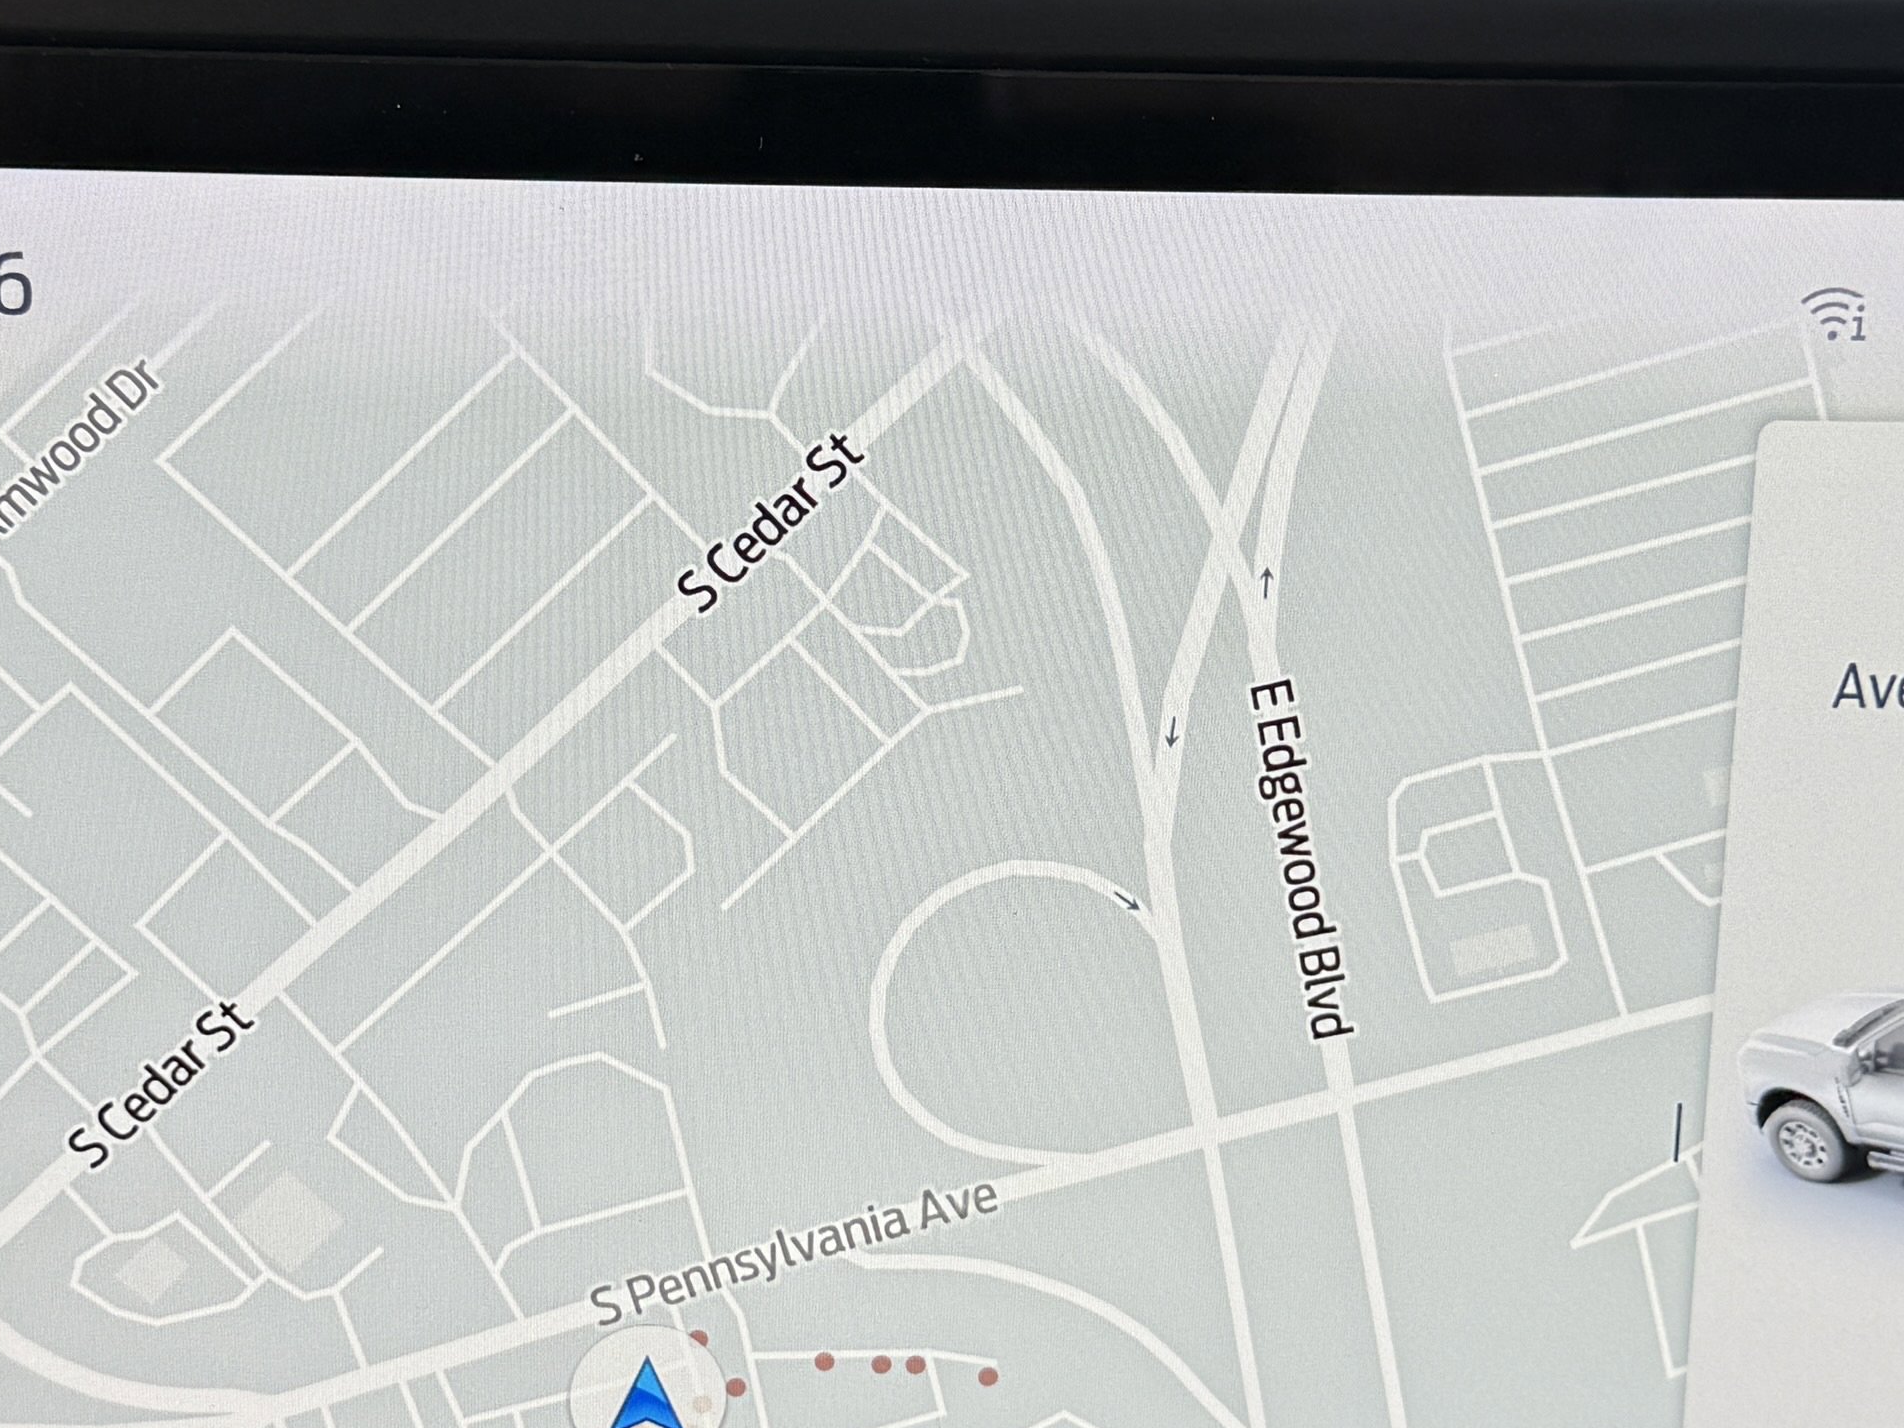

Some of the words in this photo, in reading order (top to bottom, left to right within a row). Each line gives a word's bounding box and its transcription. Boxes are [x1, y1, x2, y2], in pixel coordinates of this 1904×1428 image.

[103, 358, 161, 412] Dr
[677, 569, 718, 614] S
[706, 476, 819, 583] Cedar
[805, 433, 865, 489] St
[1250, 678, 1295, 711] E
[1257, 715, 1338, 940] Edgewood
[1298, 945, 1355, 1041] Blvd
[68, 1127, 109, 1169] S
[97, 1038, 207, 1141] Cedar
[195, 1001, 255, 1052] St
[589, 1284, 623, 1327] S
[625, 1204, 912, 1316] Pennsylvania
[919, 1181, 999, 1231] Ave
